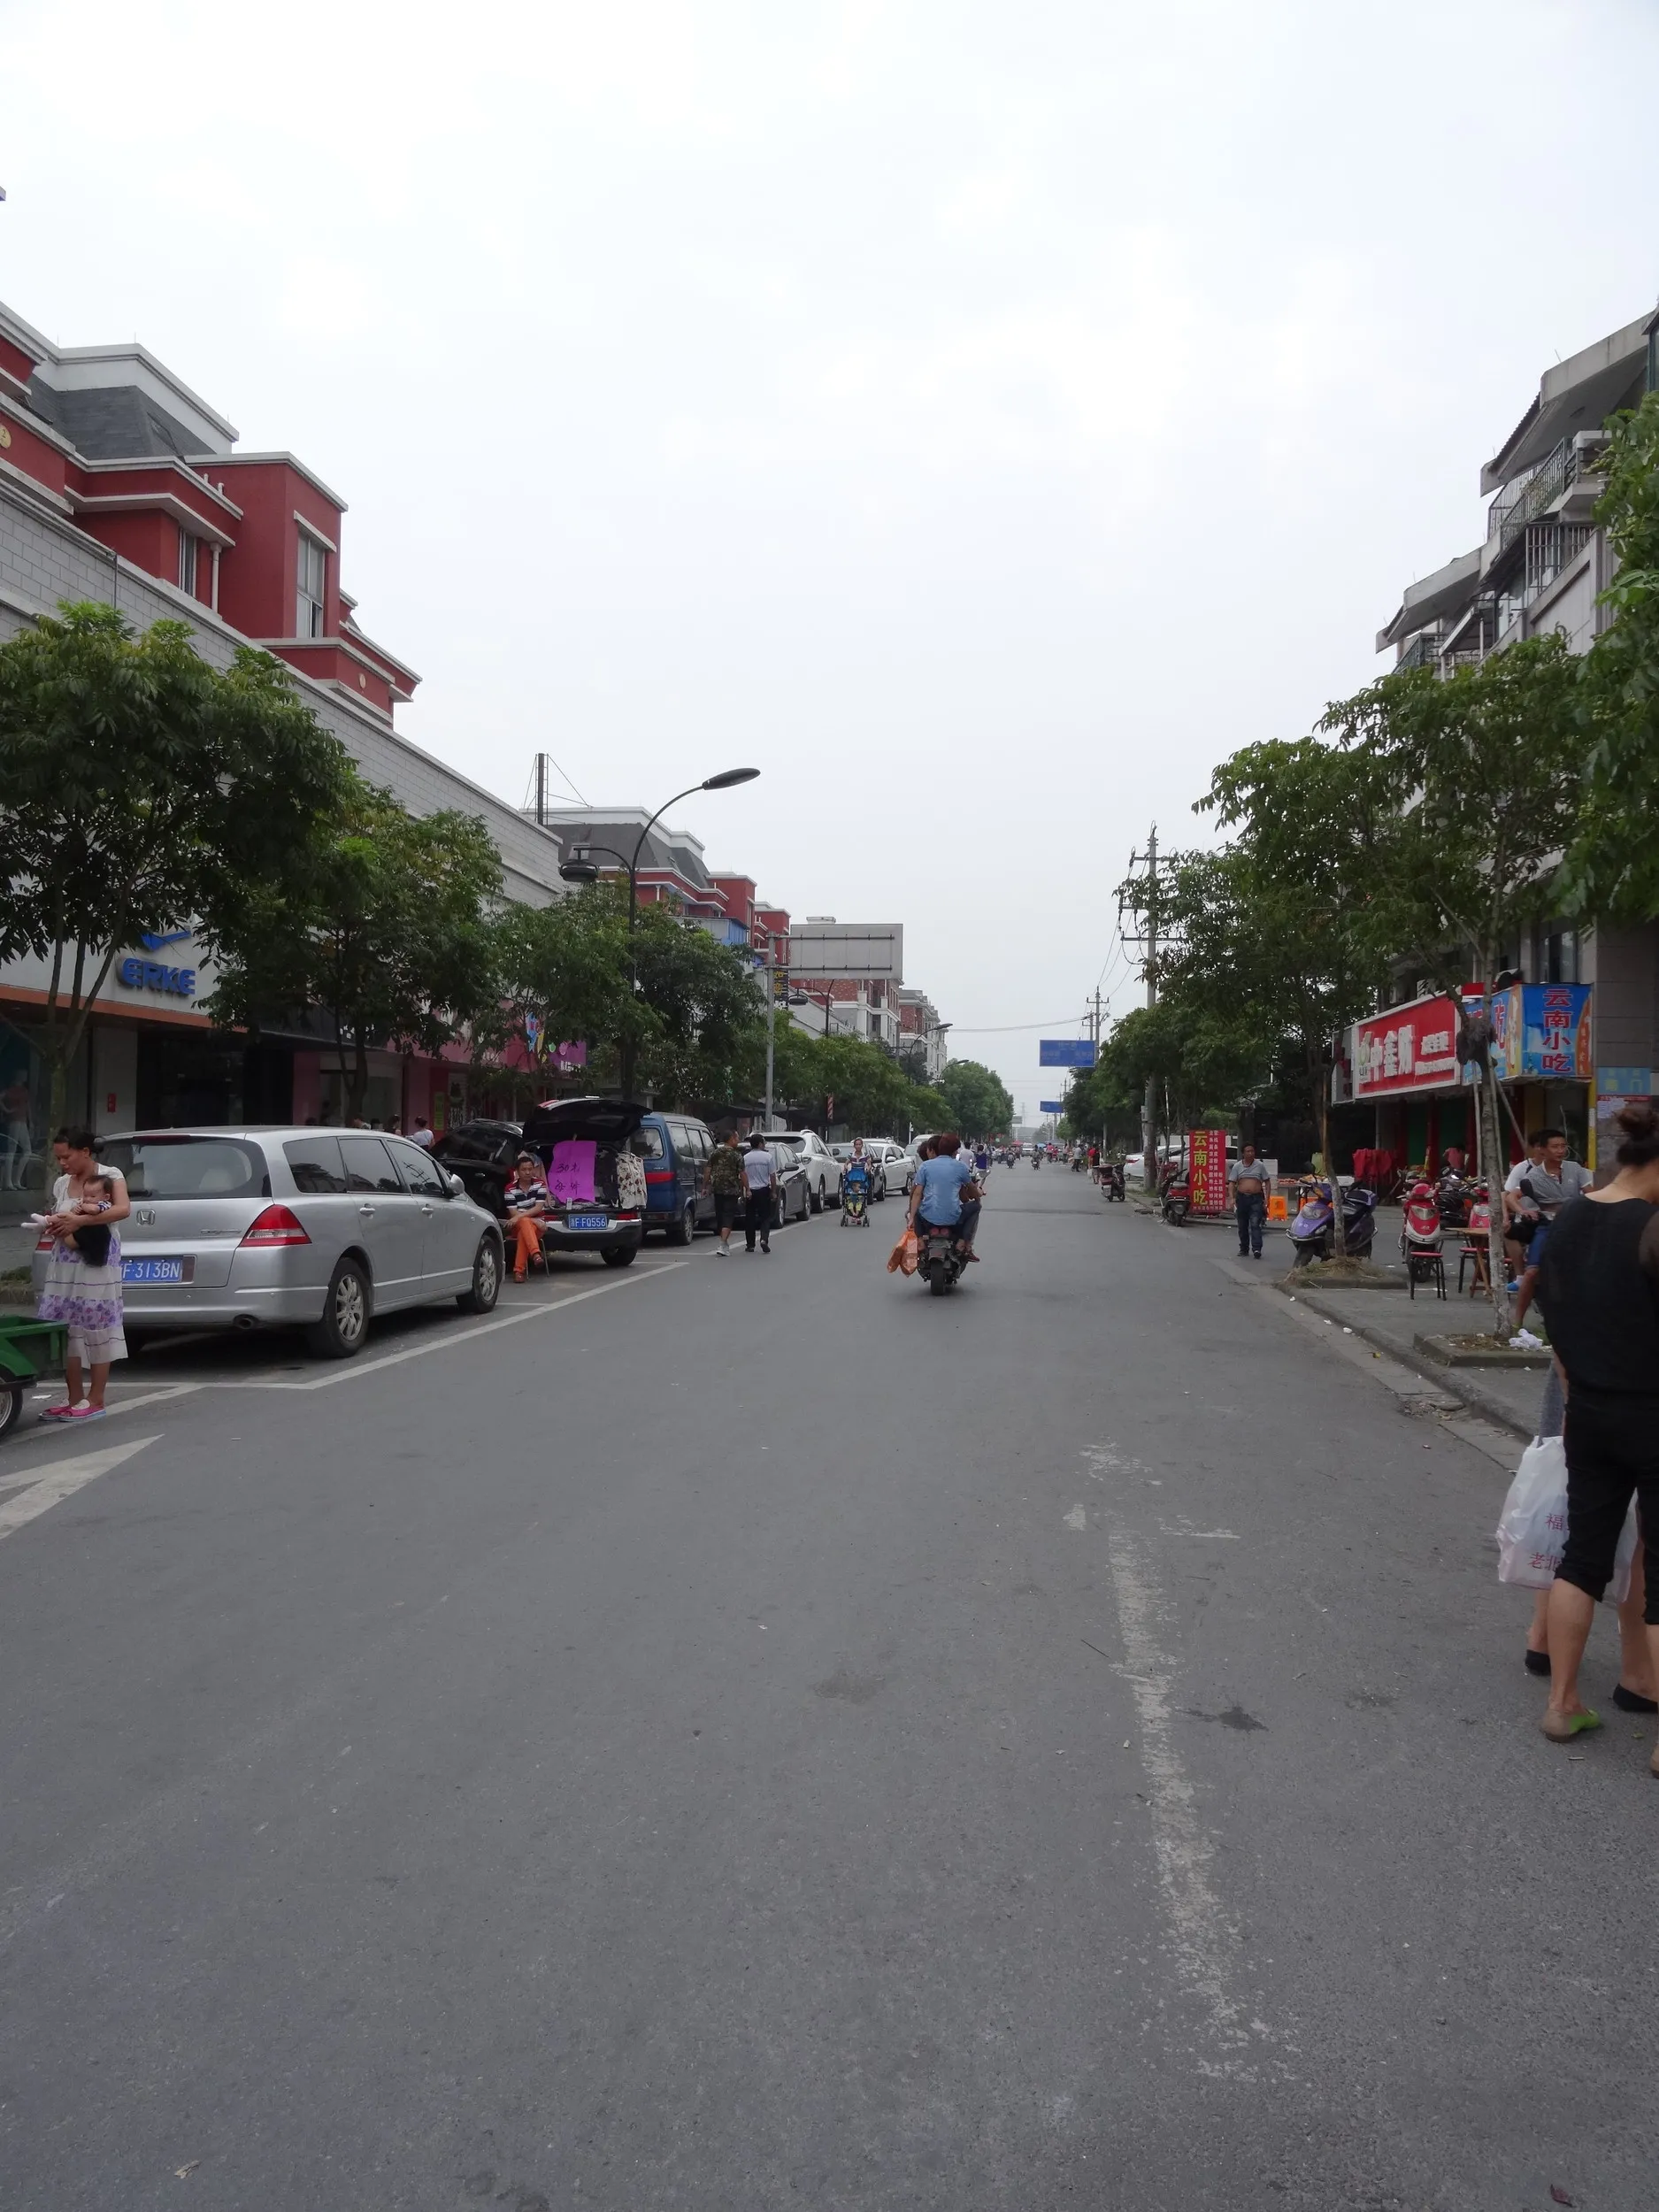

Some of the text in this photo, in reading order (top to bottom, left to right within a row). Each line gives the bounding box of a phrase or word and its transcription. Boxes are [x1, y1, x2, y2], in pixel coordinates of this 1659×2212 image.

[122, 957, 196, 995] ERKE
[1542, 988, 1572, 1073] 云南小吃
[1194, 1131, 1208, 1205] 云南小吃
[121, 1263, 180, 1279] F·313BN
[1545, 1513, 1564, 1531] 福
